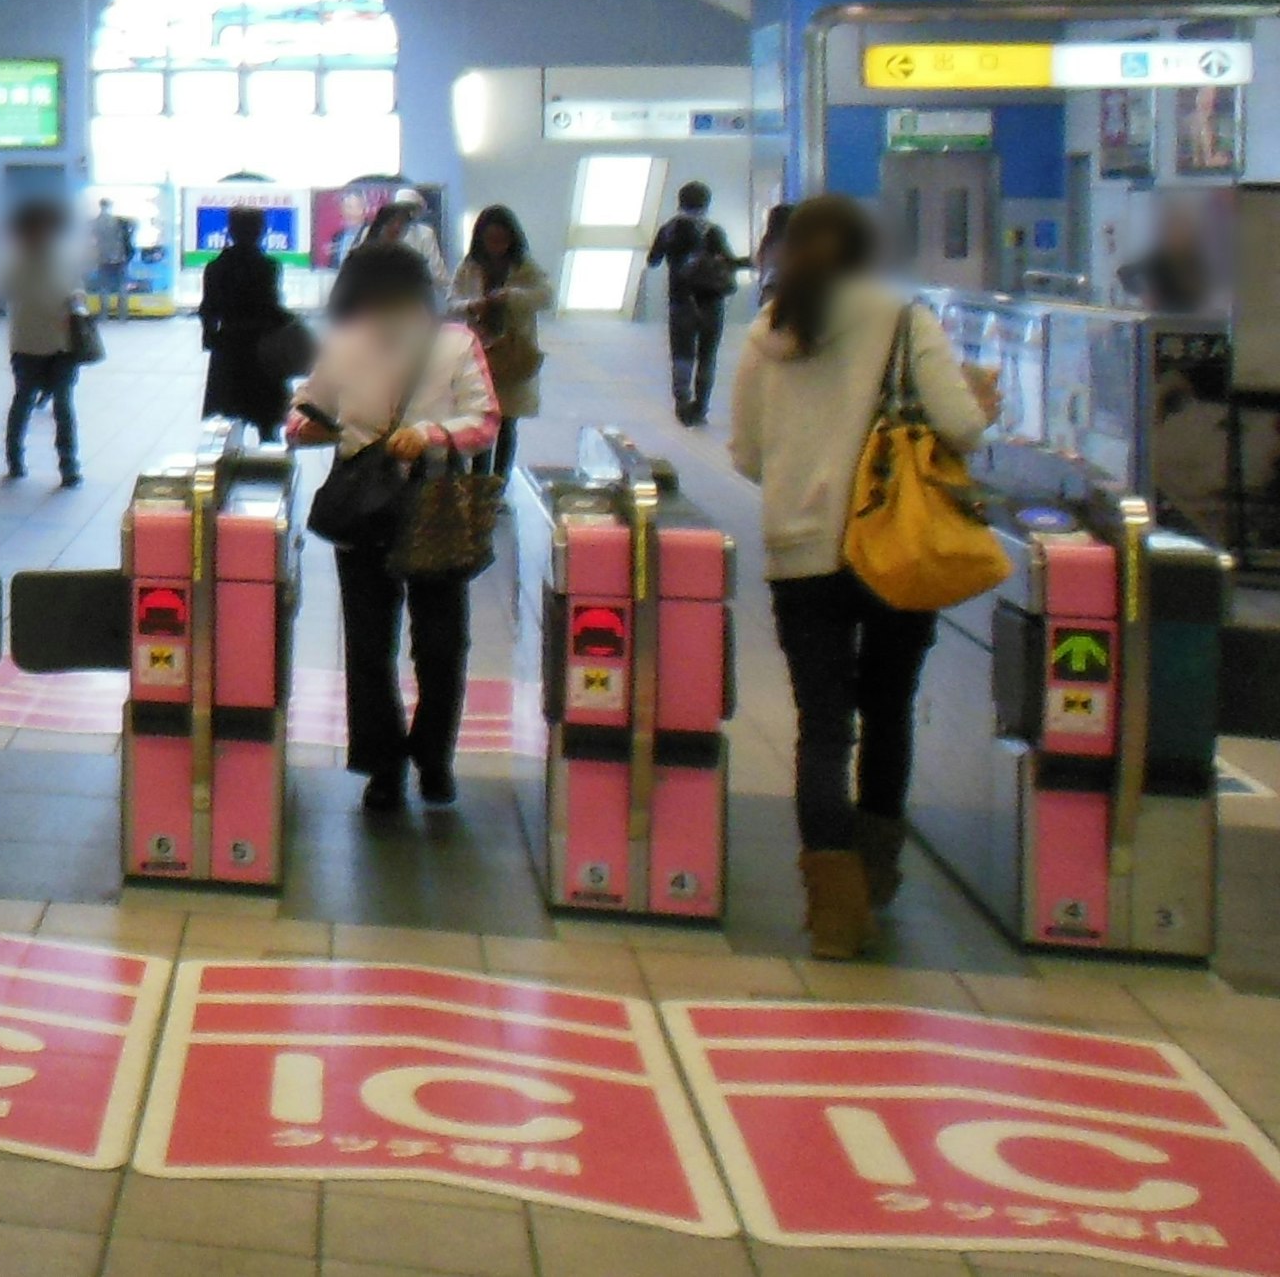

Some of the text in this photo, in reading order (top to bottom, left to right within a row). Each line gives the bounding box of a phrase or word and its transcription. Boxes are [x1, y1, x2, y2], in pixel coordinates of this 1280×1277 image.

[270, 1053, 583, 1142] IC
[271, 1129, 583, 1178] タッチ専用
[826, 1104, 1200, 1214] IC
[876, 1190, 1229, 1250] タッチ専用
